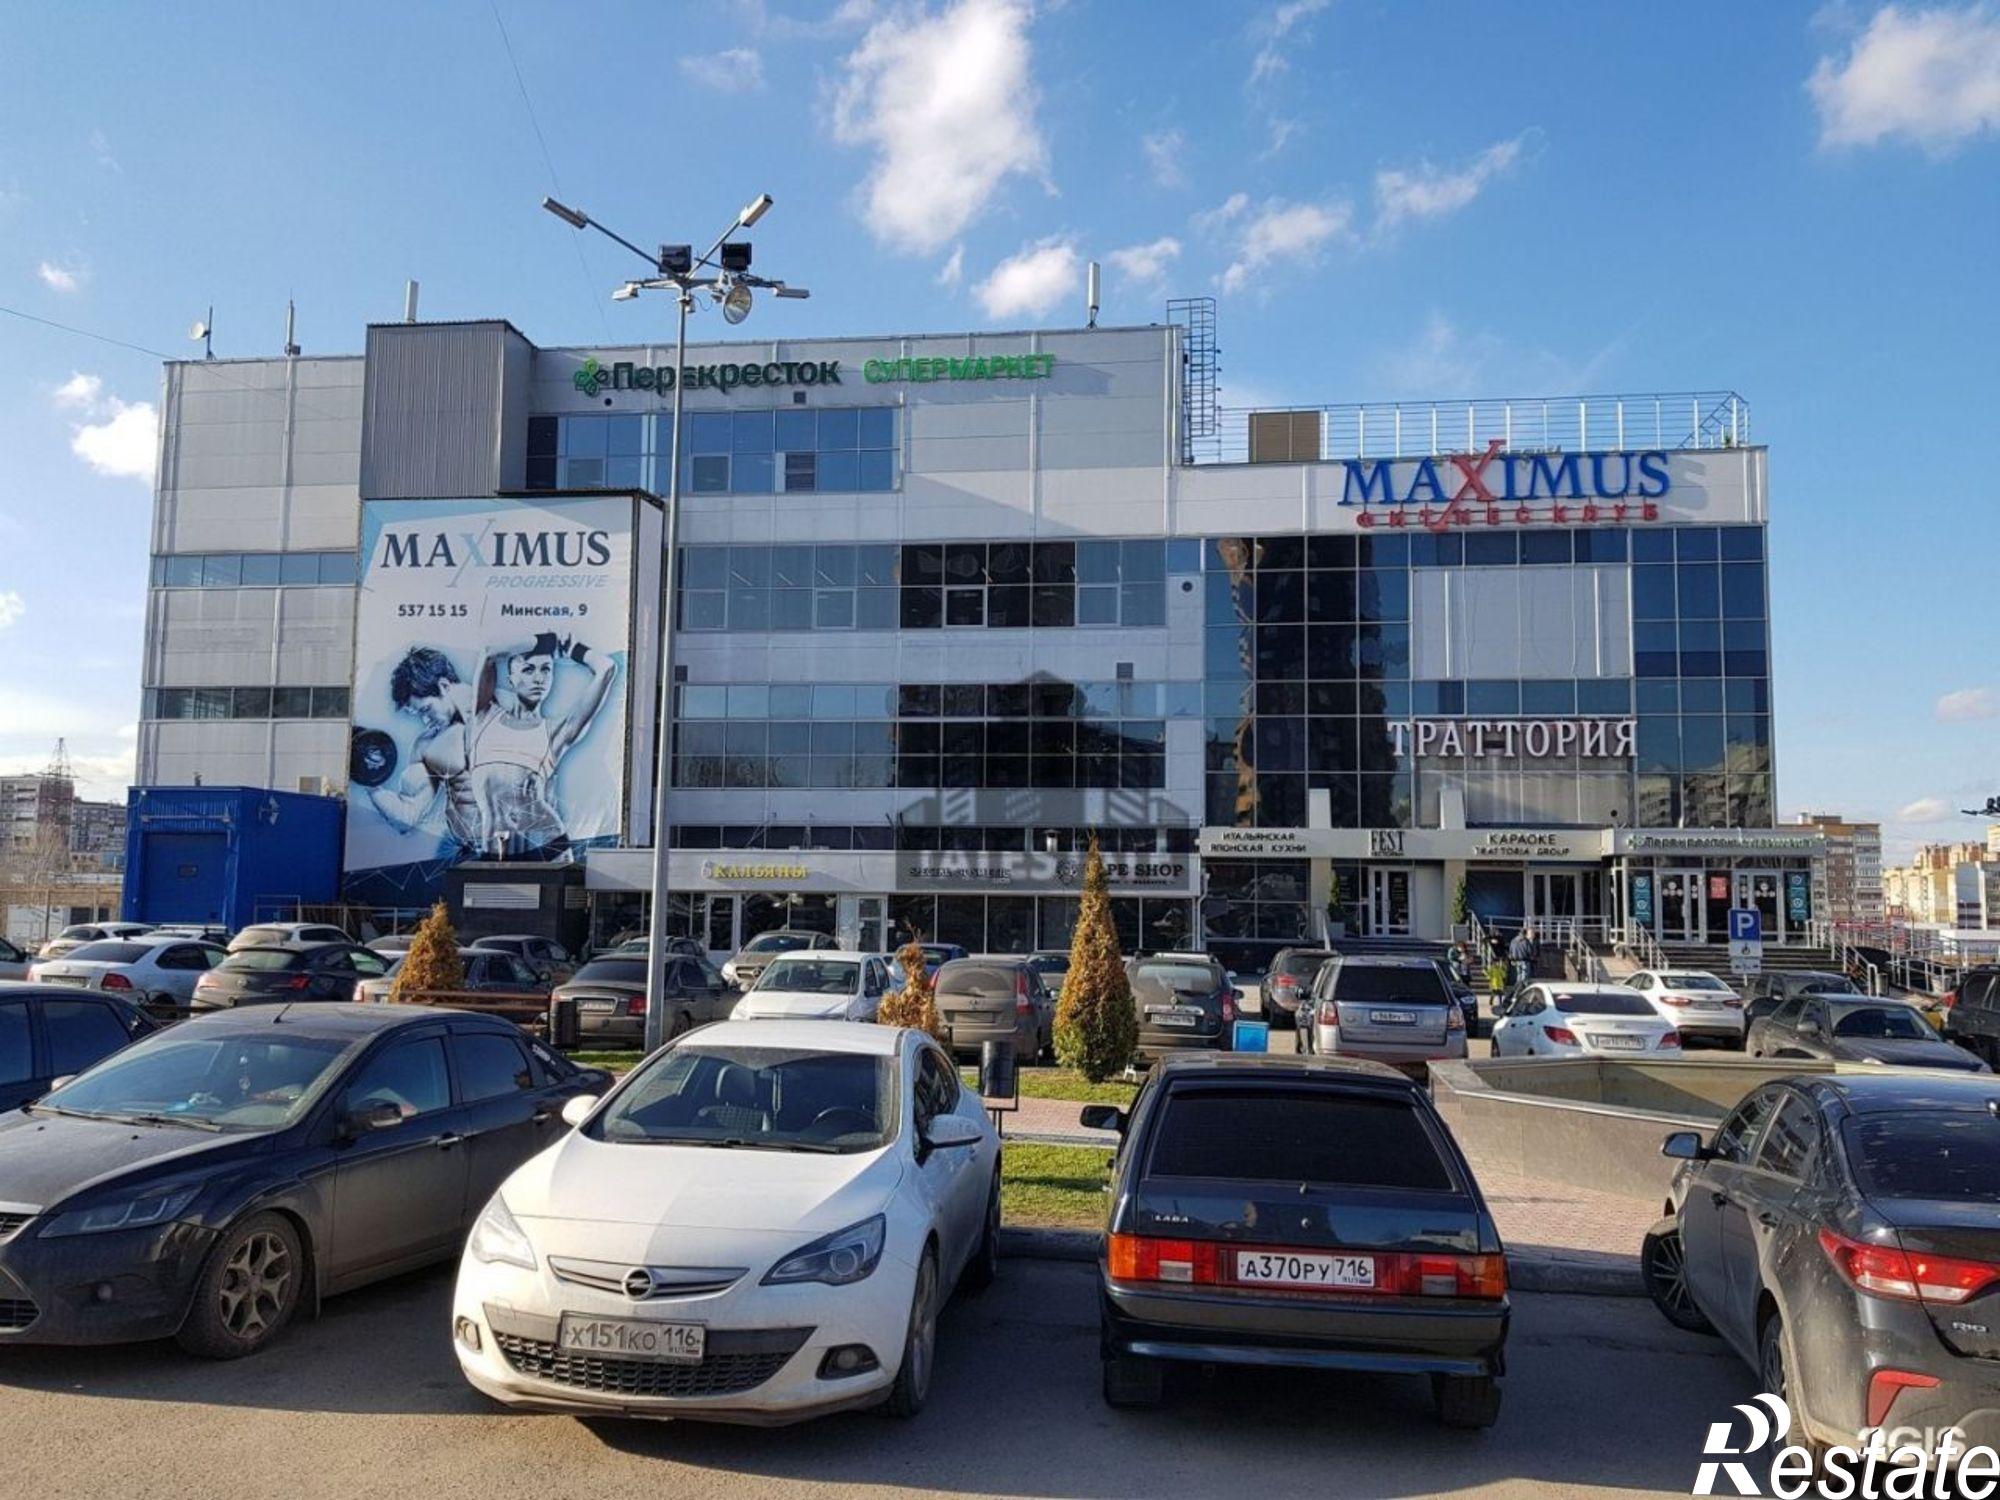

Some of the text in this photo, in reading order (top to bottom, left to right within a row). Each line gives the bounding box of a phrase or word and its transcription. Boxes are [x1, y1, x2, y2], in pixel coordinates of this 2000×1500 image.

[613, 353, 1056, 396] Перекресток СУПЕРМАРКЕТ
[1338, 440, 1671, 518] MAXIMUS
[1553, 503, 1658, 524] КЛУБ
[380, 518, 611, 578] MAXIMUS
[486, 575, 609, 588] PROGRESSIVE
[398, 603, 588, 618] 537 15 15 Минская, 9
[1387, 721, 1638, 757] ТРАТТОРИЯ
[1222, 832, 1295, 841] ИТАЛЬЯНСКАЯ
[1371, 831, 1405, 850] FEST
[1487, 833, 1557, 845] КАРАОКЕ
[1210, 843, 1306, 853] ЯПОНСКАЯ КУХНИ
[1134, 863, 1184, 877] SHOP
[1736, 912, 1754, 937] P
